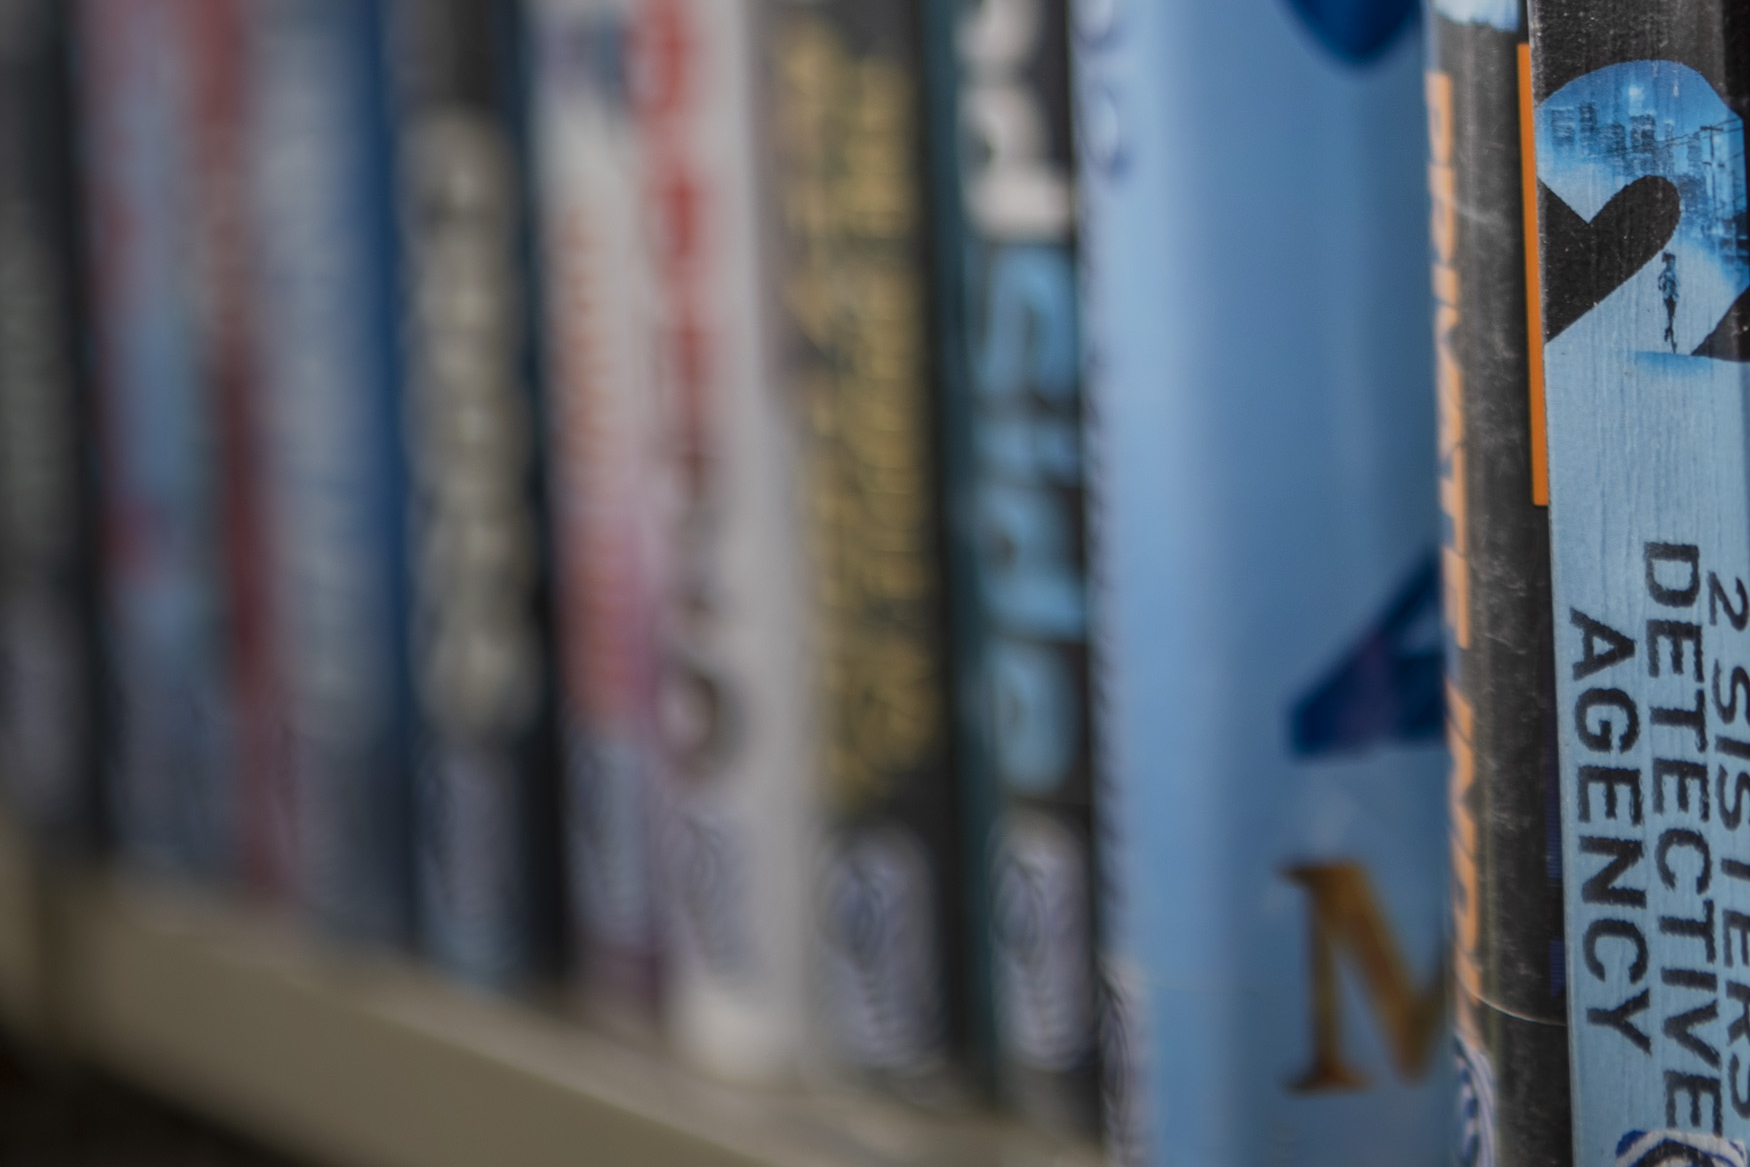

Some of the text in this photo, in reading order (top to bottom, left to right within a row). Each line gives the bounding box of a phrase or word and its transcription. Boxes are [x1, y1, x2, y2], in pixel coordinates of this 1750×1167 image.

[1707, 570, 1750, 632] 2
[1569, 606, 1654, 1056] AGENCY
[1642, 539, 1724, 1140] DETECTIVE
